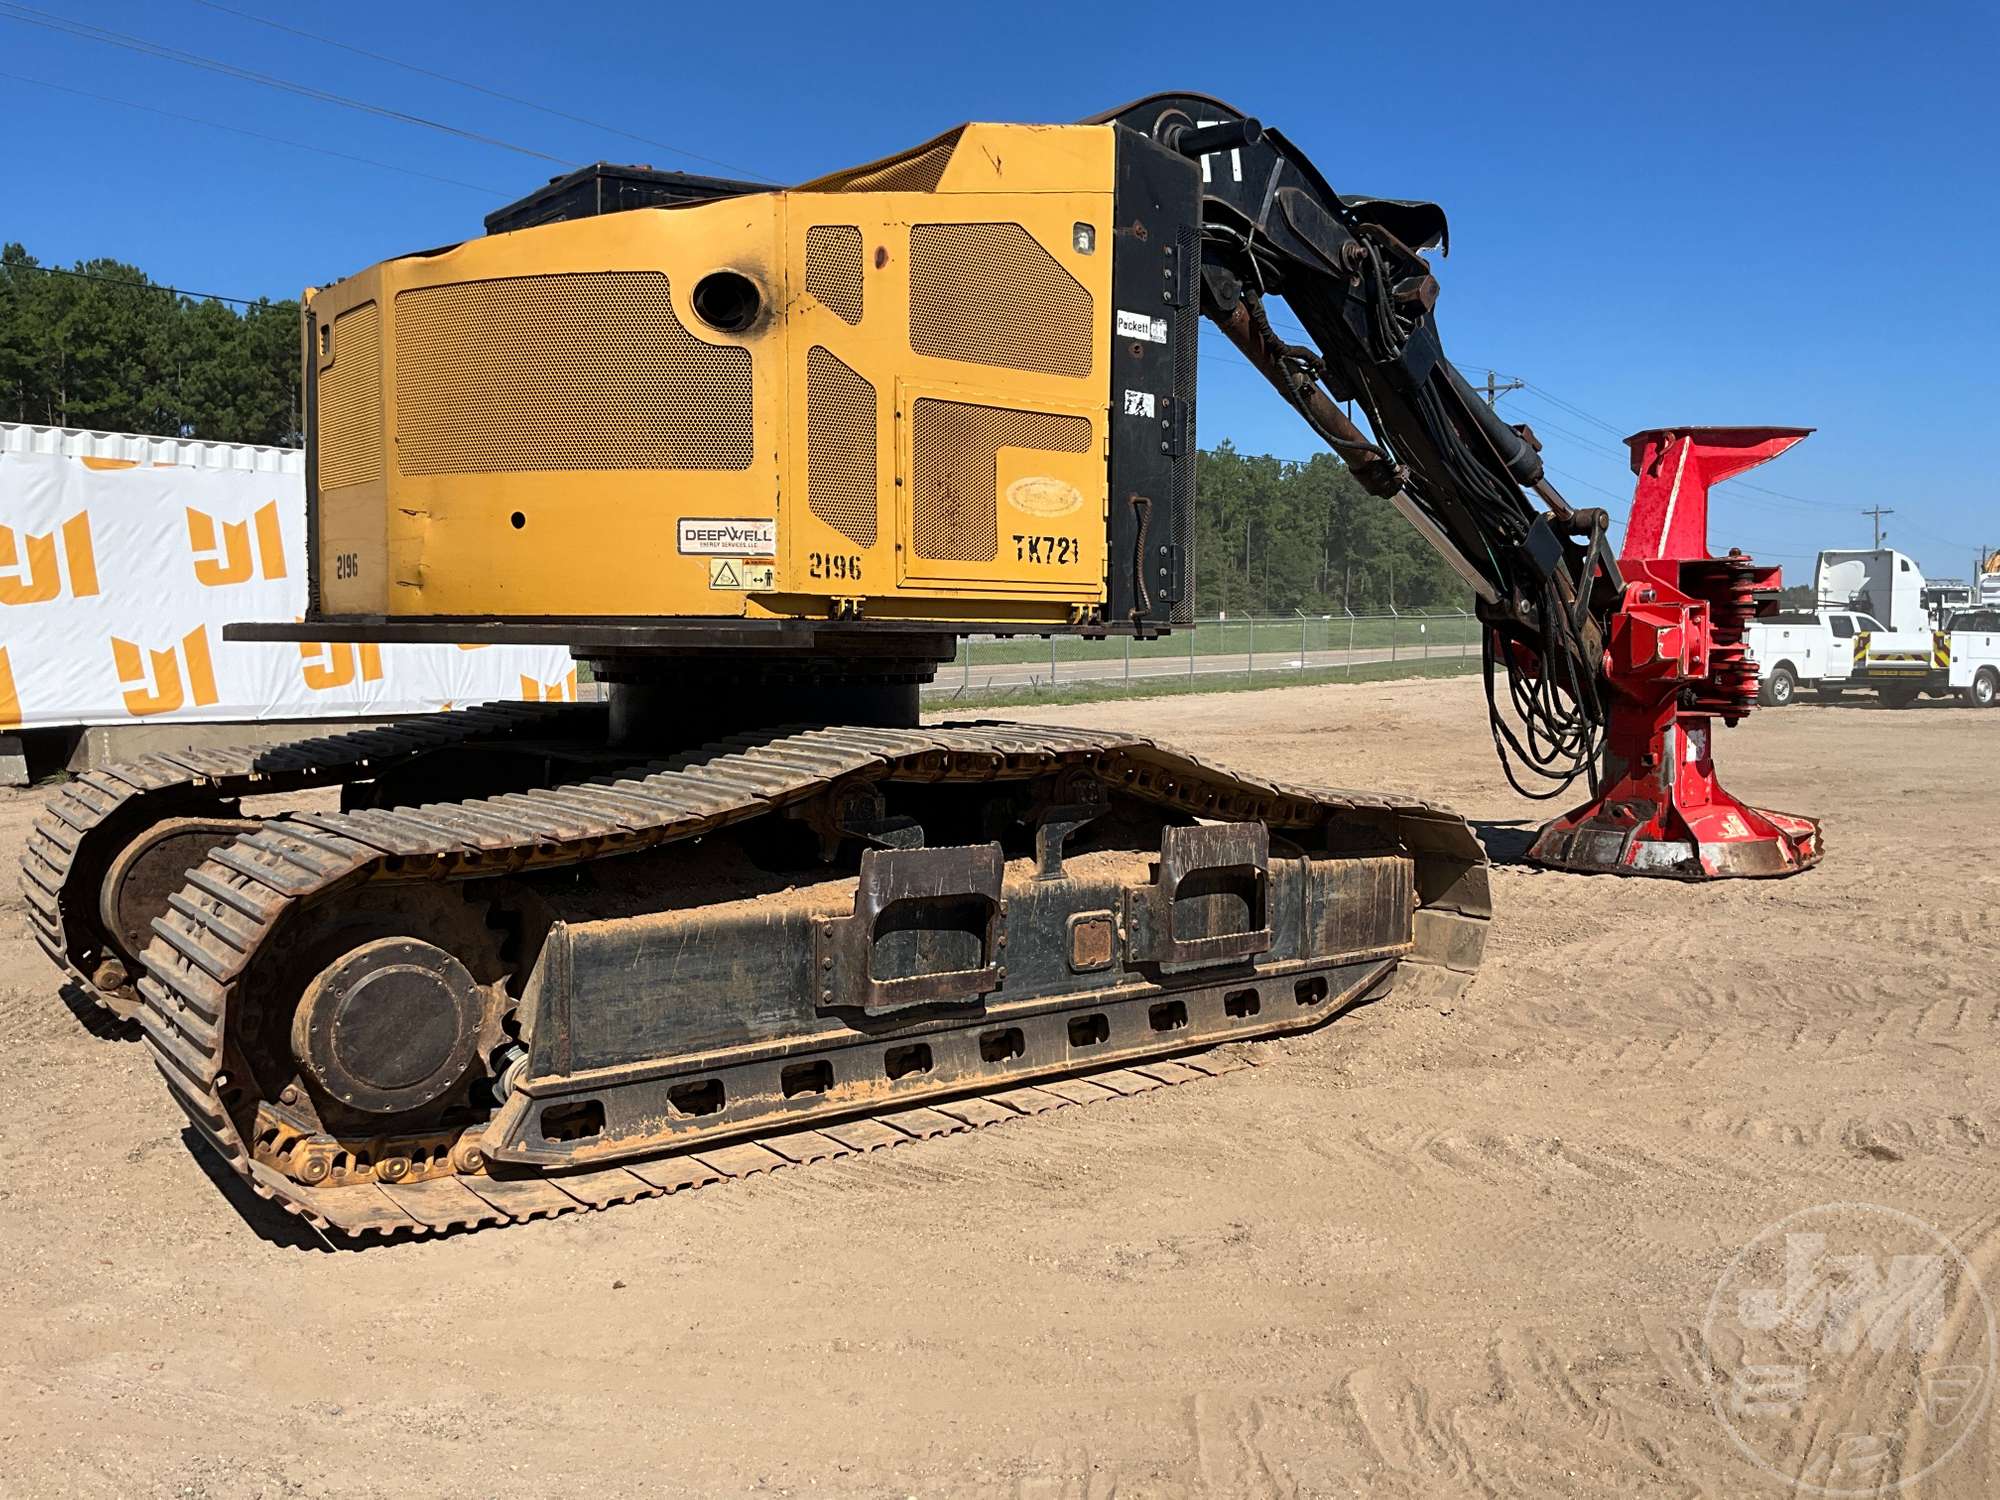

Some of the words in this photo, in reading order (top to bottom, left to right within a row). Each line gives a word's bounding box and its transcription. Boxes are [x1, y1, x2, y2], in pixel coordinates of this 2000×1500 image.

[685, 526, 772, 542] DEEPWELL
[1012, 535, 1079, 564] TK721
[337, 553, 358, 579] 2196
[809, 552, 862, 580] 2196
